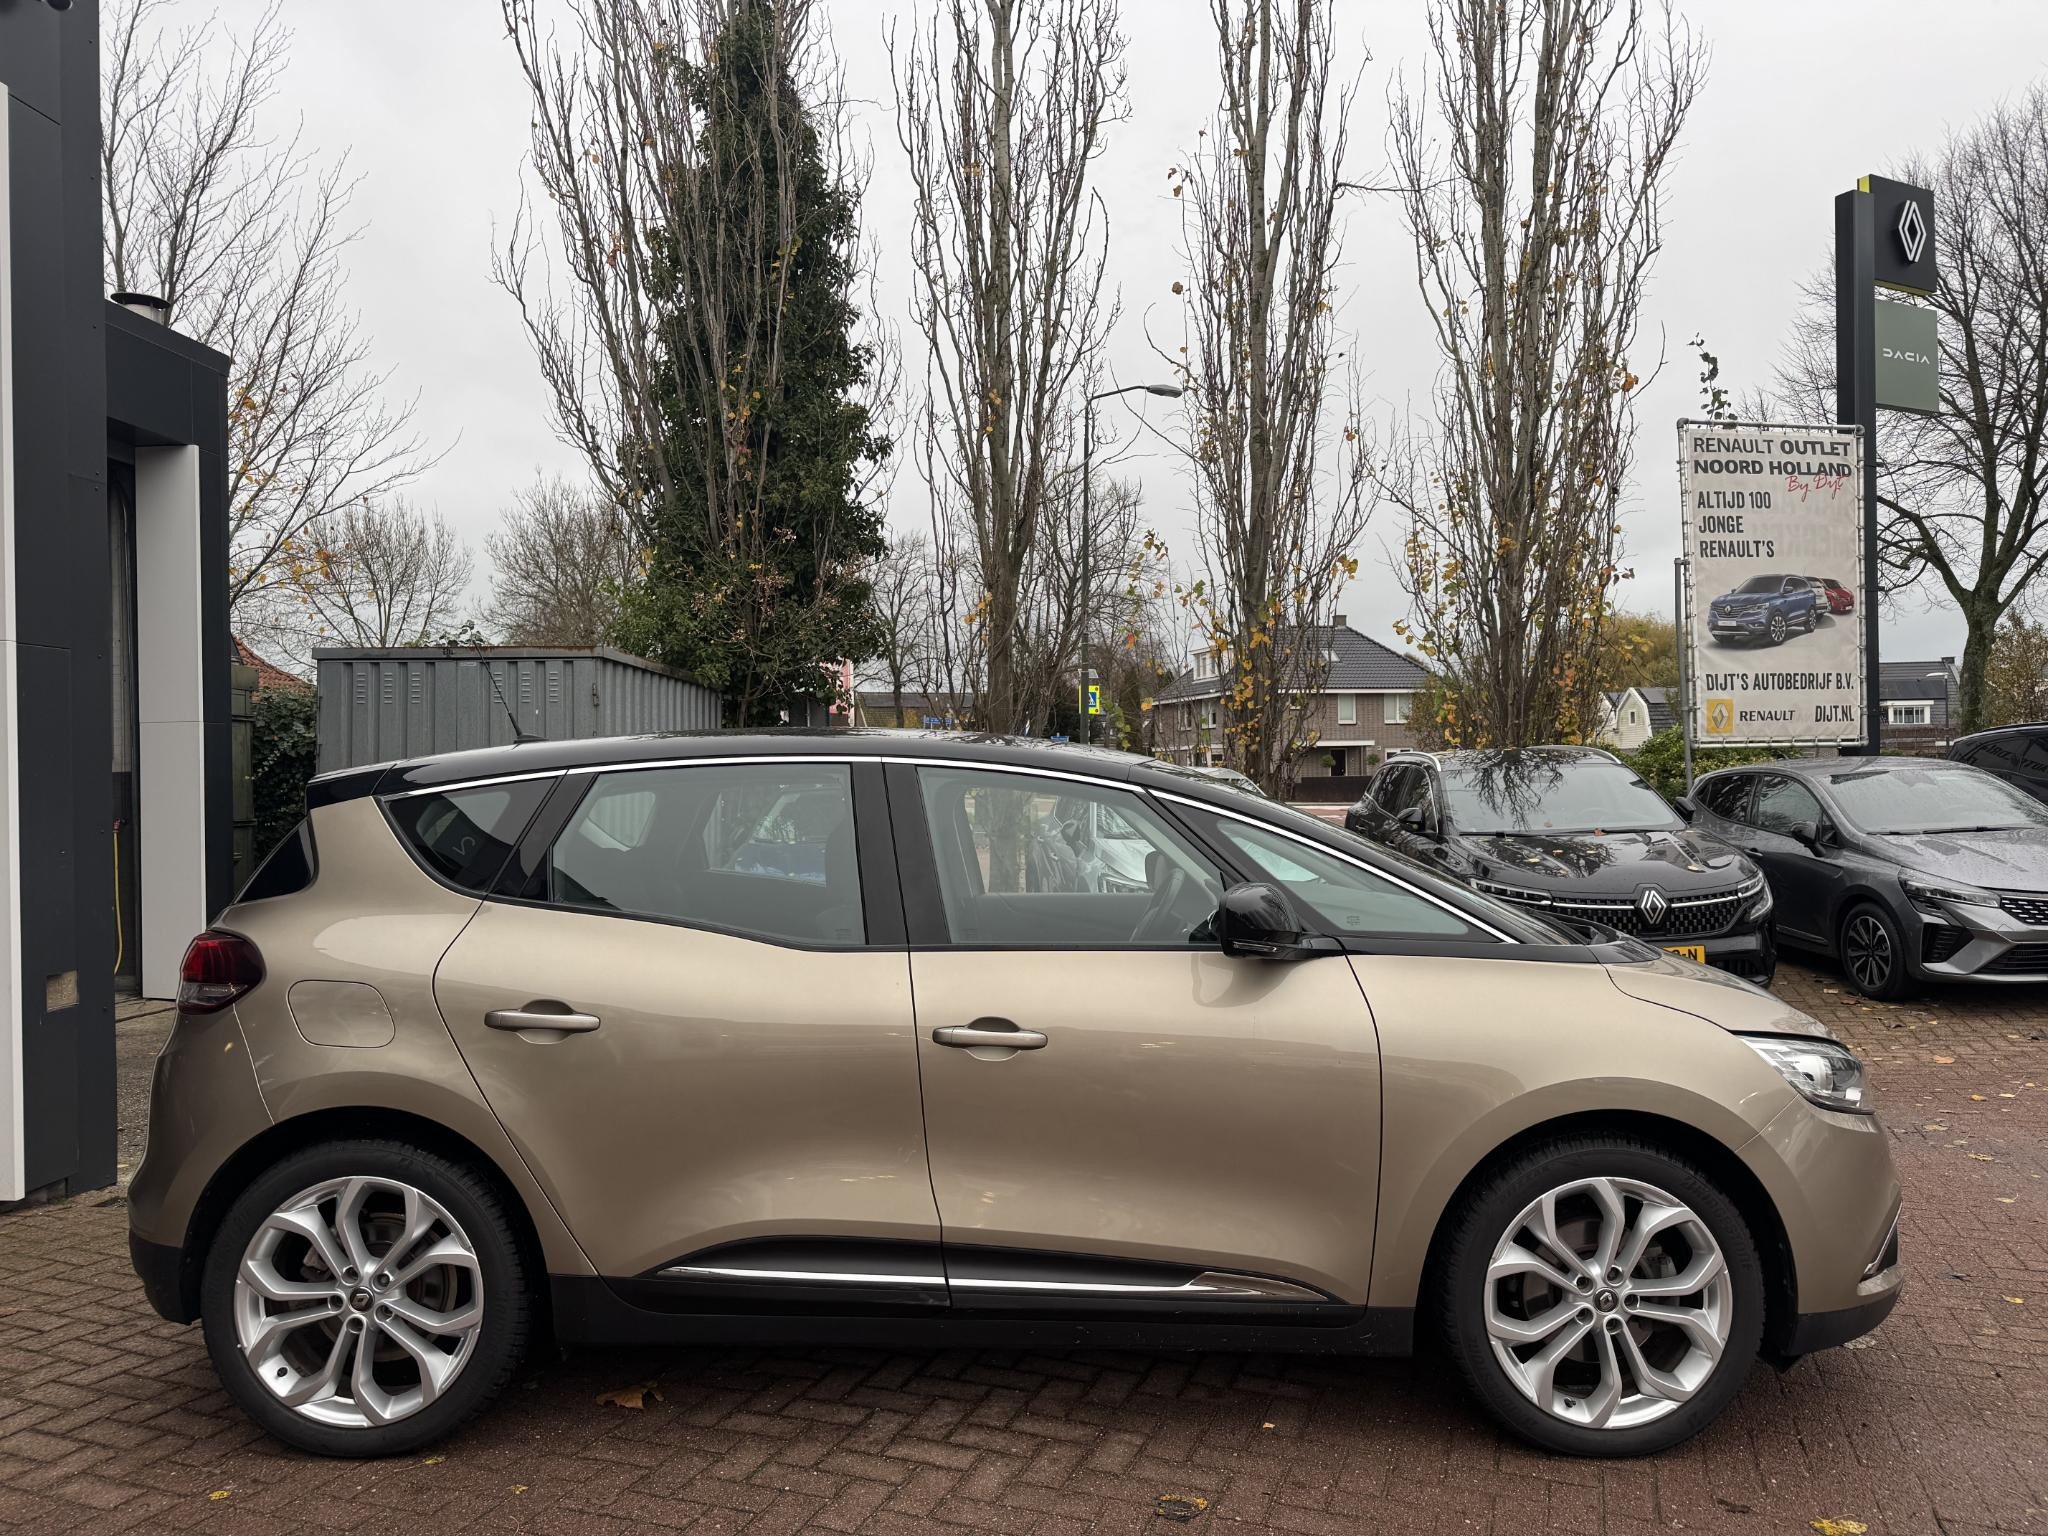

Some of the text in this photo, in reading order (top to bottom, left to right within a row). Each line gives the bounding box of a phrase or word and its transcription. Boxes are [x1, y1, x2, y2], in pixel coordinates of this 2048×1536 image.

[1882, 347, 1930, 365] DACIA
[1693, 437, 1851, 456] RENAULT OUTLET
[1694, 459, 1852, 478] NOORD HOLLAND
[1785, 475, 1811, 502] By
[1697, 490, 1772, 509] ALTIJD 100
[1698, 515, 1745, 534] JONGE
[1699, 540, 1775, 558] RENAULT'S
[1705, 672, 1854, 691] DIJT'S AUTOBEDRIJF B.V.
[1739, 710, 1796, 722] RENAULT
[1814, 705, 1855, 723] DIJT.NL
